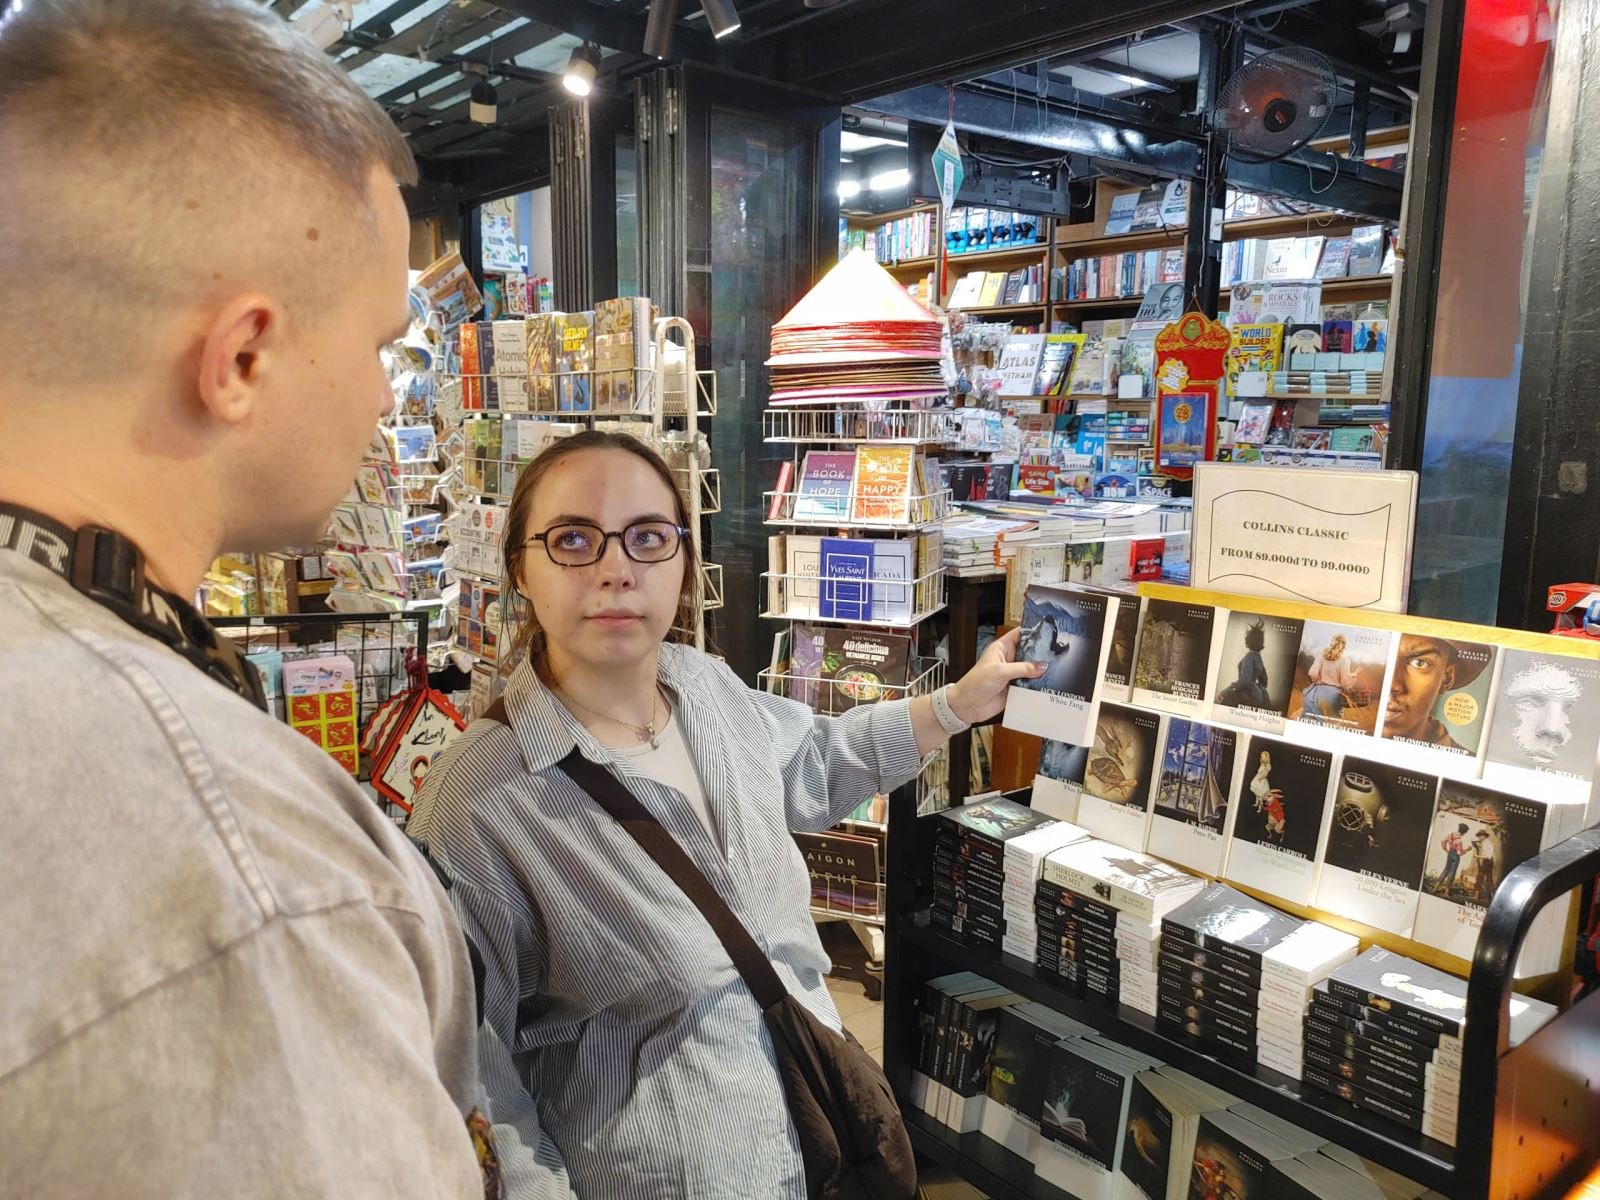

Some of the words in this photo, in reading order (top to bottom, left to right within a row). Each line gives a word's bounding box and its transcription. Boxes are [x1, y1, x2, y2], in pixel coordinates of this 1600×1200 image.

[1268, 293, 1298, 301] ROCKS
[1241, 328, 1271, 338] WORLD
[497, 350, 527, 362] Atomic
[1002, 357, 1035, 367] ATLAS
[812, 470, 846, 478] BOOK
[810, 488, 841, 496] HOPE
[864, 485, 901, 494] HAPPY
[1104, 487, 1127, 497] HOW
[1144, 486, 1172, 497] SPACE
[1243, 521, 1295, 535] COLLINS
[1297, 526, 1349, 540] CLASSIC
[1221, 547, 1253, 559] FROM
[1300, 557, 1318, 568] TO
[830, 565, 844, 573] YVES
[846, 566, 865, 574] SAINT
[855, 642, 889, 655] delicious
[1458, 650, 1489, 658] COLLINS
[1458, 654, 1488, 662] CLASSICS
[1171, 685, 1199, 694] HODGSON
[1174, 680, 1200, 689] FRANCES
[1040, 687, 1056, 697] JACK
[1056, 690, 1086, 702] LONDON
[1050, 696, 1068, 708] White
[1069, 699, 1084, 711] Fang
[1161, 695, 1177, 703] Secret
[1178, 698, 1198, 706] Garden
[1238, 704, 1257, 714] EMILY
[1449, 707, 1471, 715] MOTION
[1229, 709, 1258, 722] Wuthering
[1259, 715, 1281, 725] Heights
[1447, 712, 1471, 721] PICTURE
[1296, 717, 1320, 729] LOUISA
[1393, 735, 1429, 748] SOLOMON
[1300, 754, 1326, 762] COLLINS
[1300, 759, 1325, 767] CLASSICS
[1398, 776, 1428, 786] COLLINS
[1398, 780, 1427, 790] CLASSICS
[1505, 807, 1537, 818] CLASSICS
[1506, 802, 1538, 813] COLLINS
[1193, 828, 1206, 837] Peter
[1207, 833, 1216, 841] Pan
[1257, 840, 1277, 851] LEWIS
[1278, 847, 1307, 859] CARROLL
[807, 852, 855, 866] AIGON
[1360, 868, 1382, 880] JULES
[1383, 876, 1409, 888] VERNE
[1456, 906, 1471, 917] The
